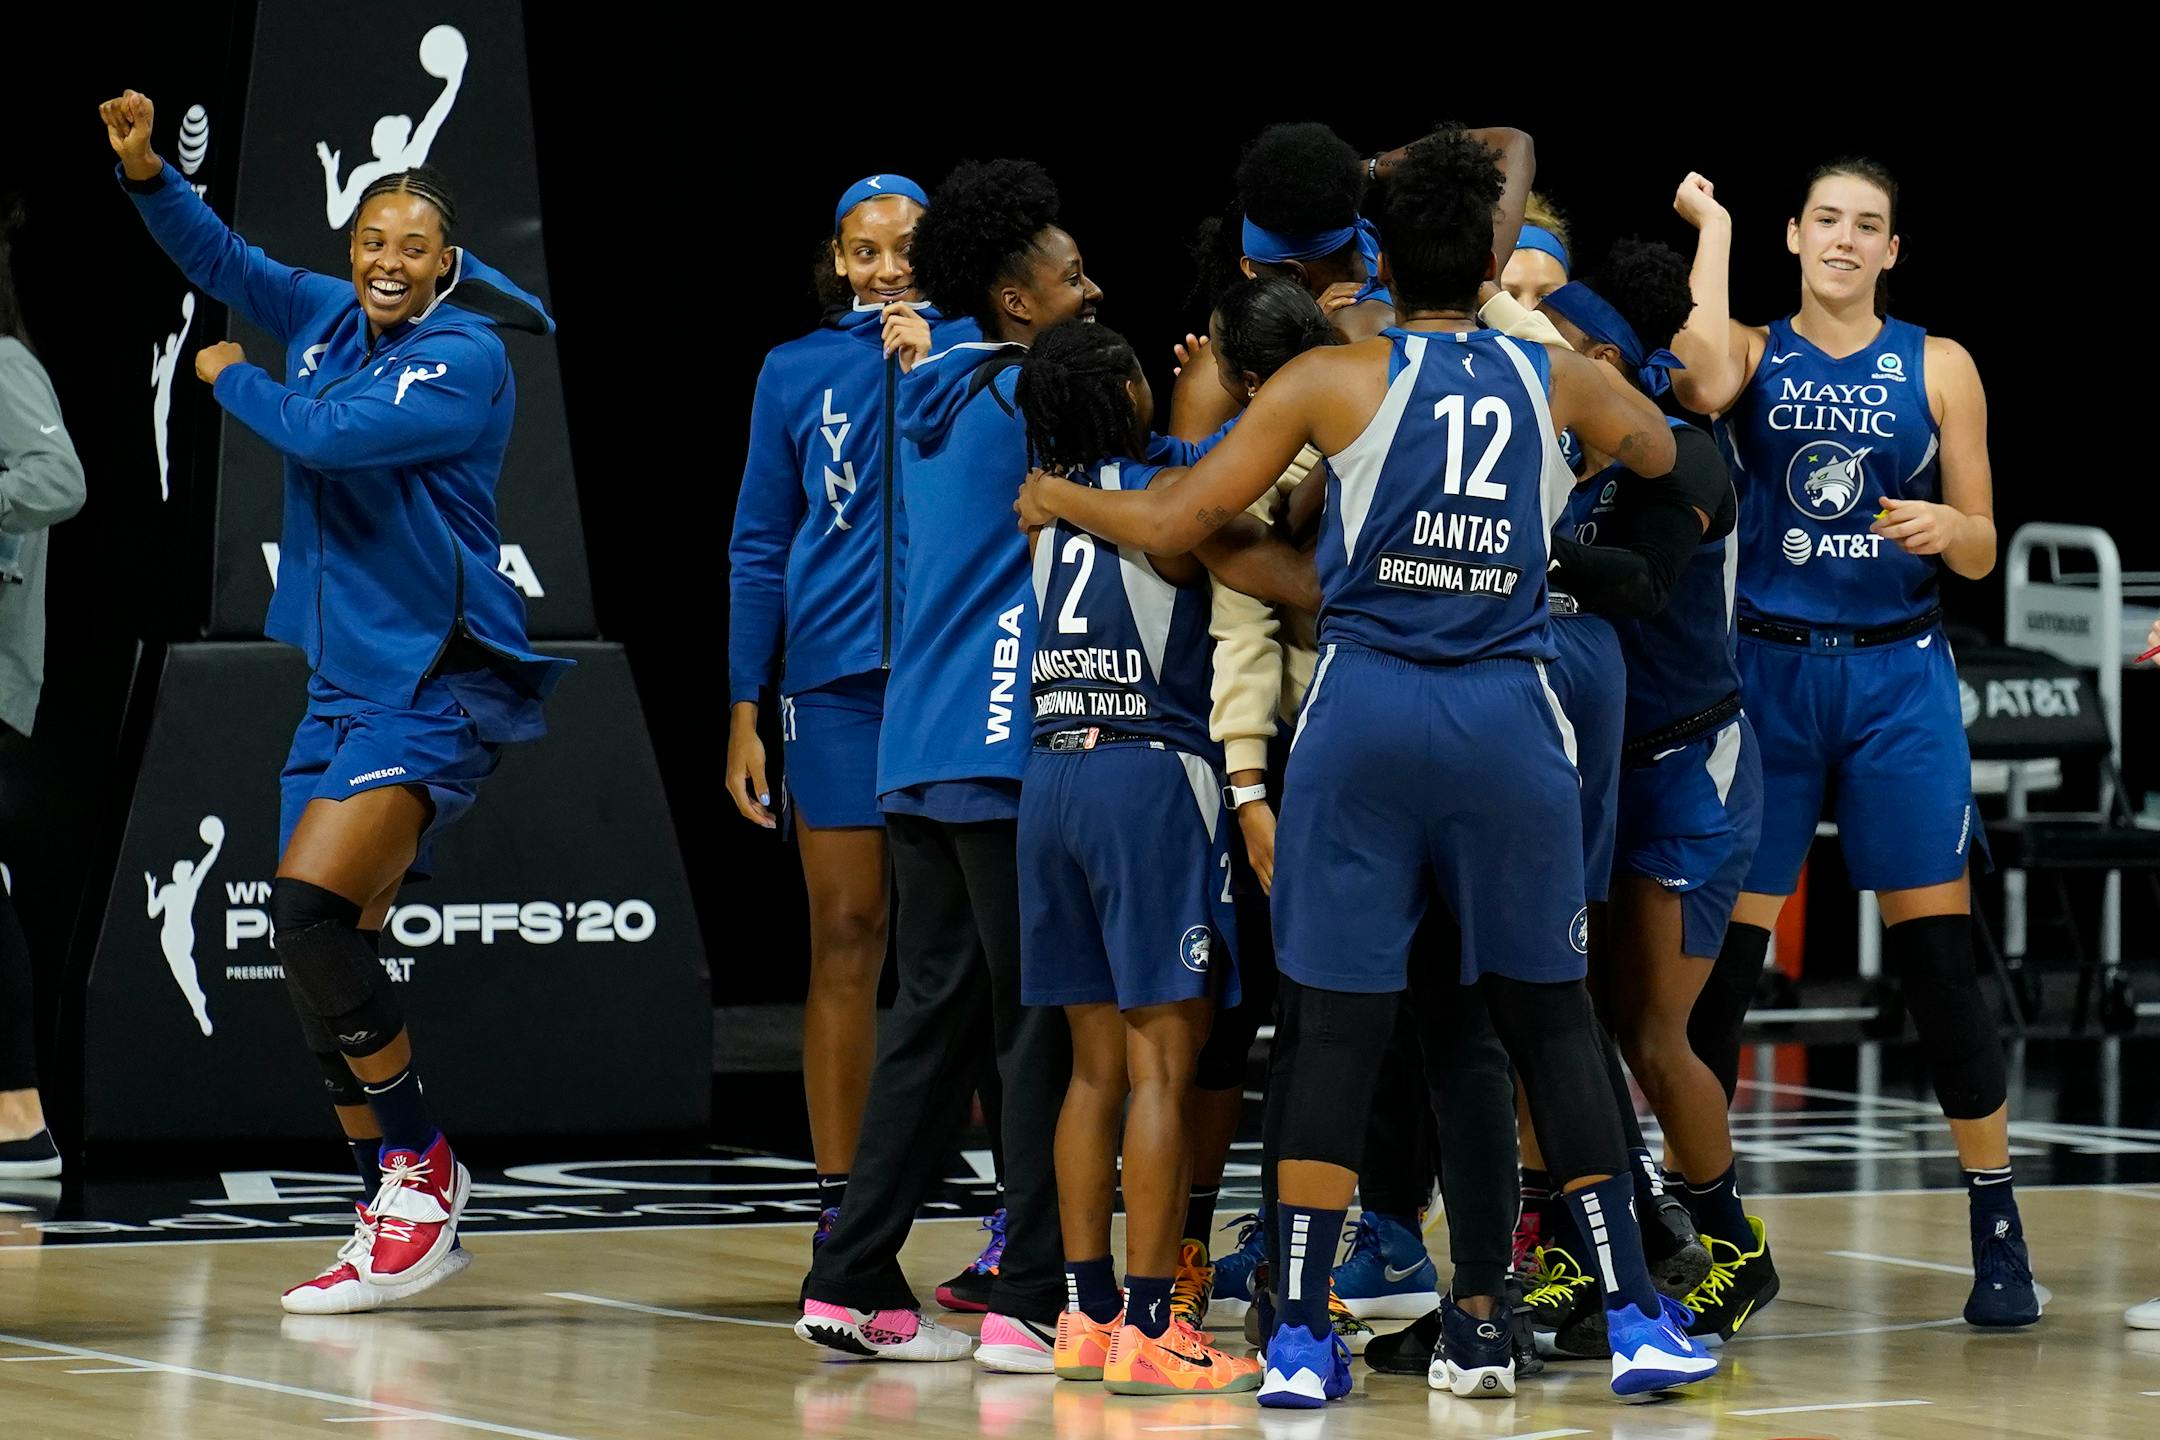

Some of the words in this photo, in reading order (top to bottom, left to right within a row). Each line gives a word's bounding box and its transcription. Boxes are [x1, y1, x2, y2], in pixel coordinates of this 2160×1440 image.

[1779, 377, 1888, 406] MAYO
[1768, 404, 1896, 438] CLINIC
[820, 388, 857, 536] LYNX
[1434, 394, 1513, 501] 12
[1412, 510, 1512, 555] DANTAS
[1816, 533, 1885, 559] AT&T
[1058, 533, 1096, 634] 2
[1379, 557, 1464, 591] BREONNA
[1469, 568, 1518, 595] TAYLOR
[985, 603, 1025, 745] WNBA
[1031, 647, 1142, 684] ANGERFIELD
[1088, 692, 1148, 716] TAYLOR
[1986, 678, 2081, 718] AT&T
[349, 766, 407, 787] MINNESOTA
[1219, 851, 1234, 903] 2
